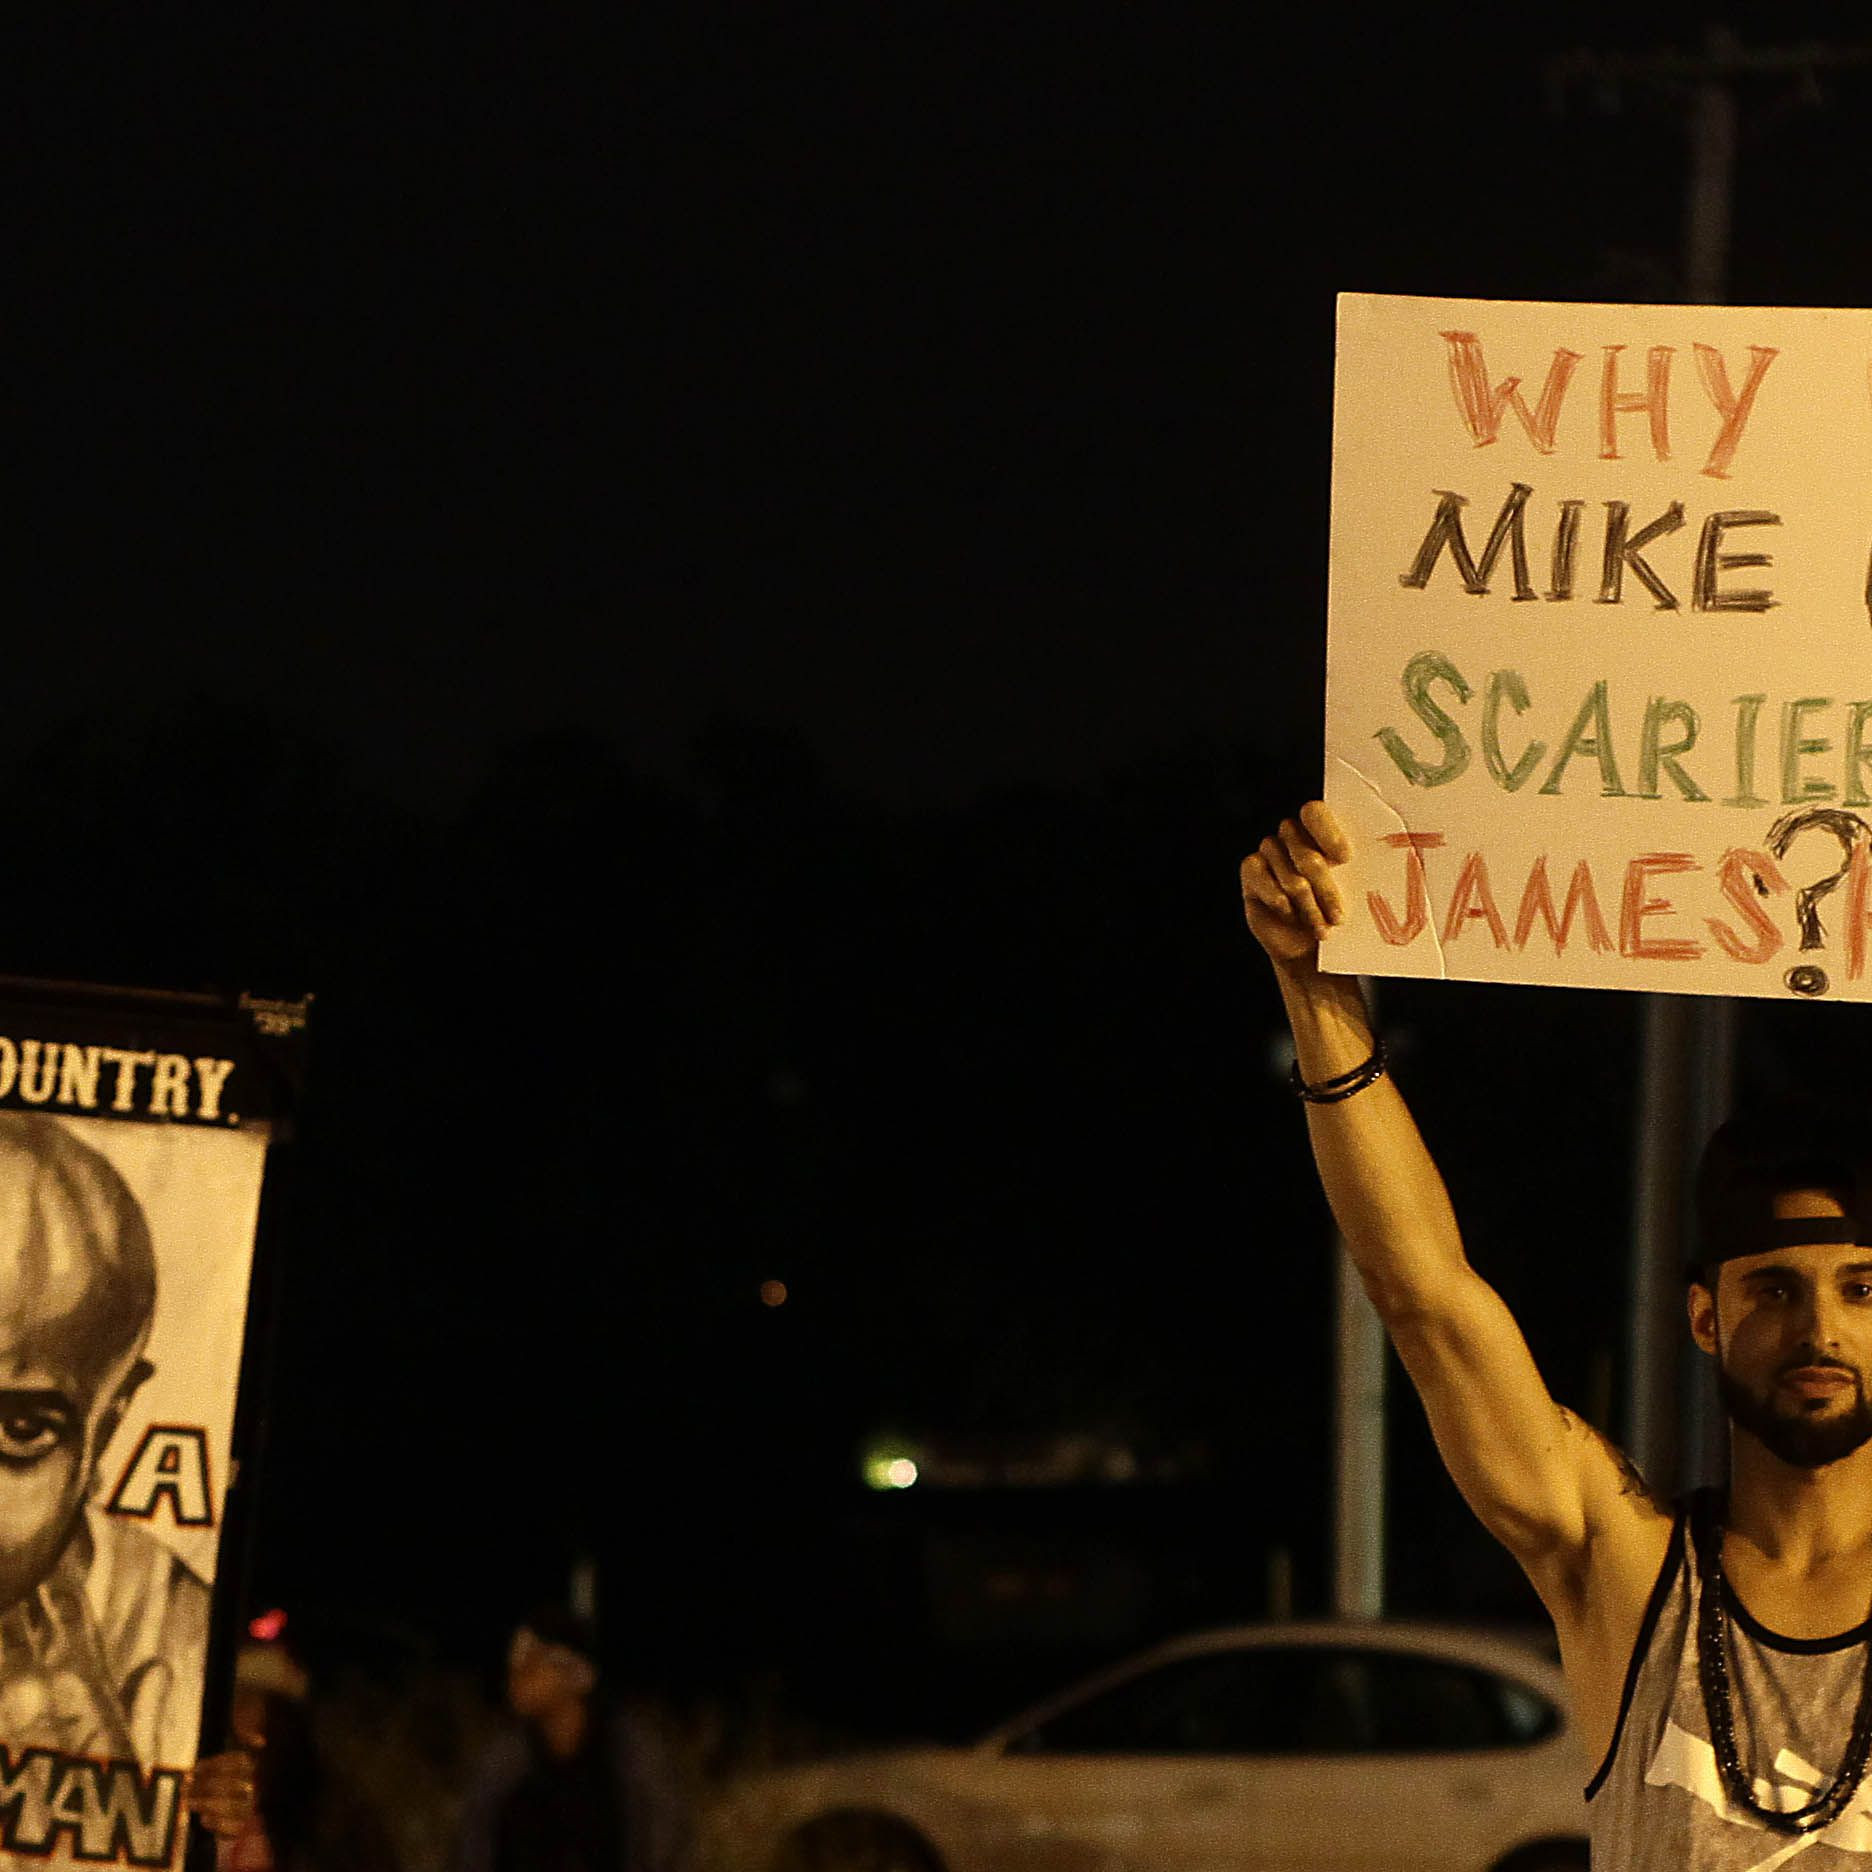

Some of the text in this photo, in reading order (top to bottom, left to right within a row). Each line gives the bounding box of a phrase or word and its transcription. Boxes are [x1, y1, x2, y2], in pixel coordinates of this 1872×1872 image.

[1439, 330, 1782, 480] WHY
[1400, 483, 1782, 613] MIKE
[1365, 831, 1789, 965] JAMES
[106, 1426, 216, 1527] A
